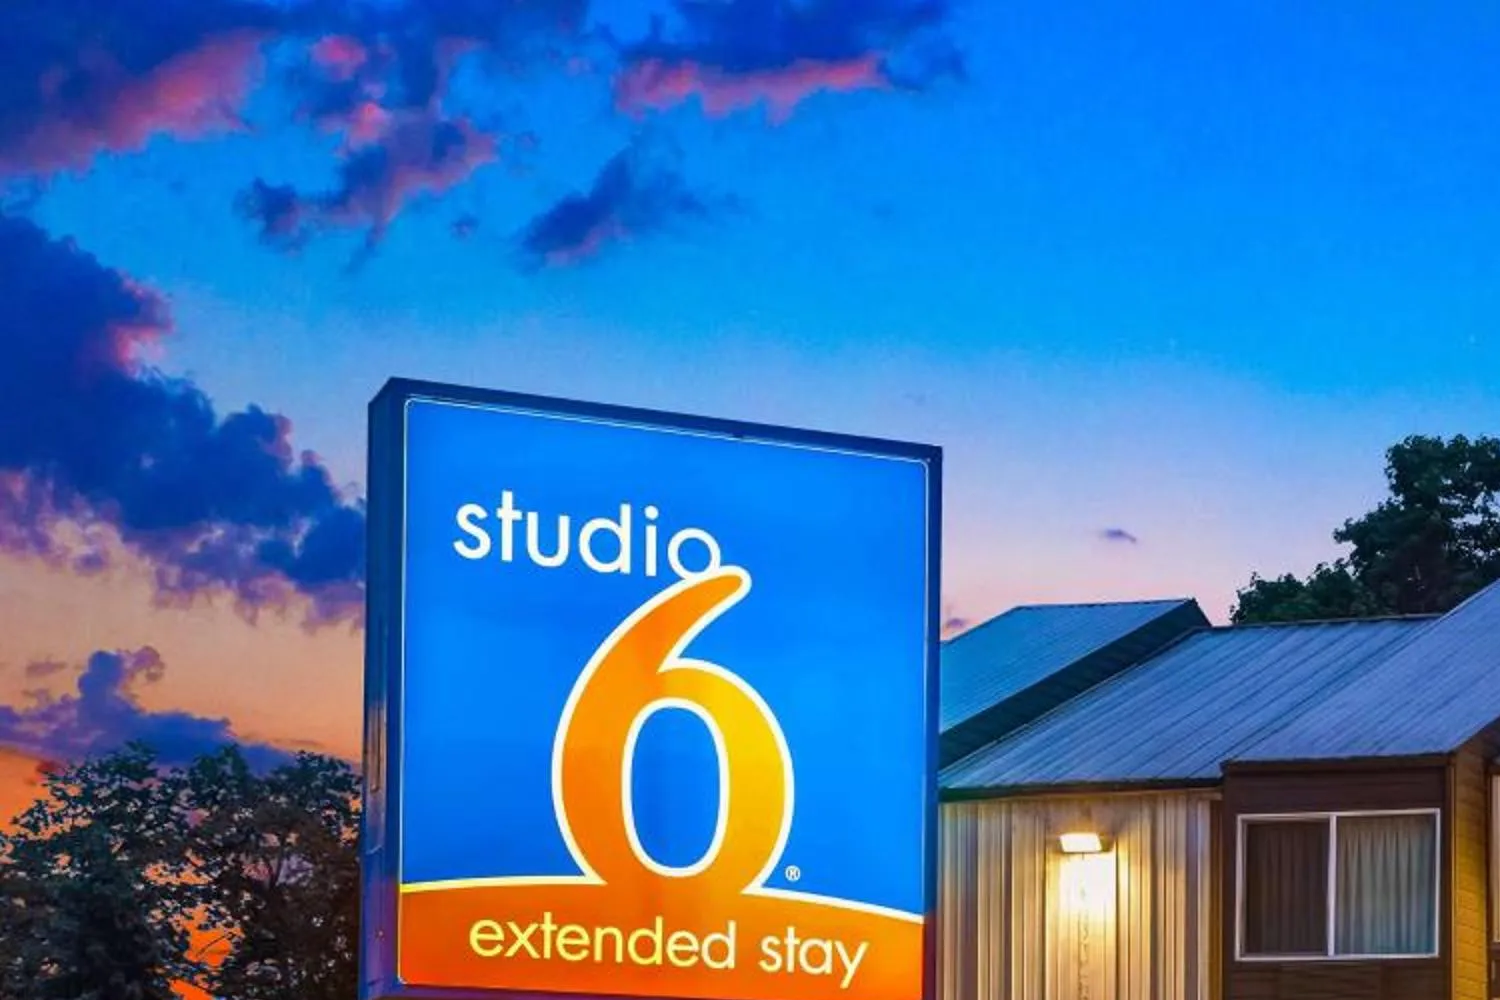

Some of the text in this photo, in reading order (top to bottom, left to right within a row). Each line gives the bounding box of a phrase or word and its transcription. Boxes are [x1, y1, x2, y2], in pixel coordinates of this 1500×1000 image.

[453, 490, 721, 581] studio
[551, 565, 794, 891] 6
[470, 912, 868, 988] extended stay
